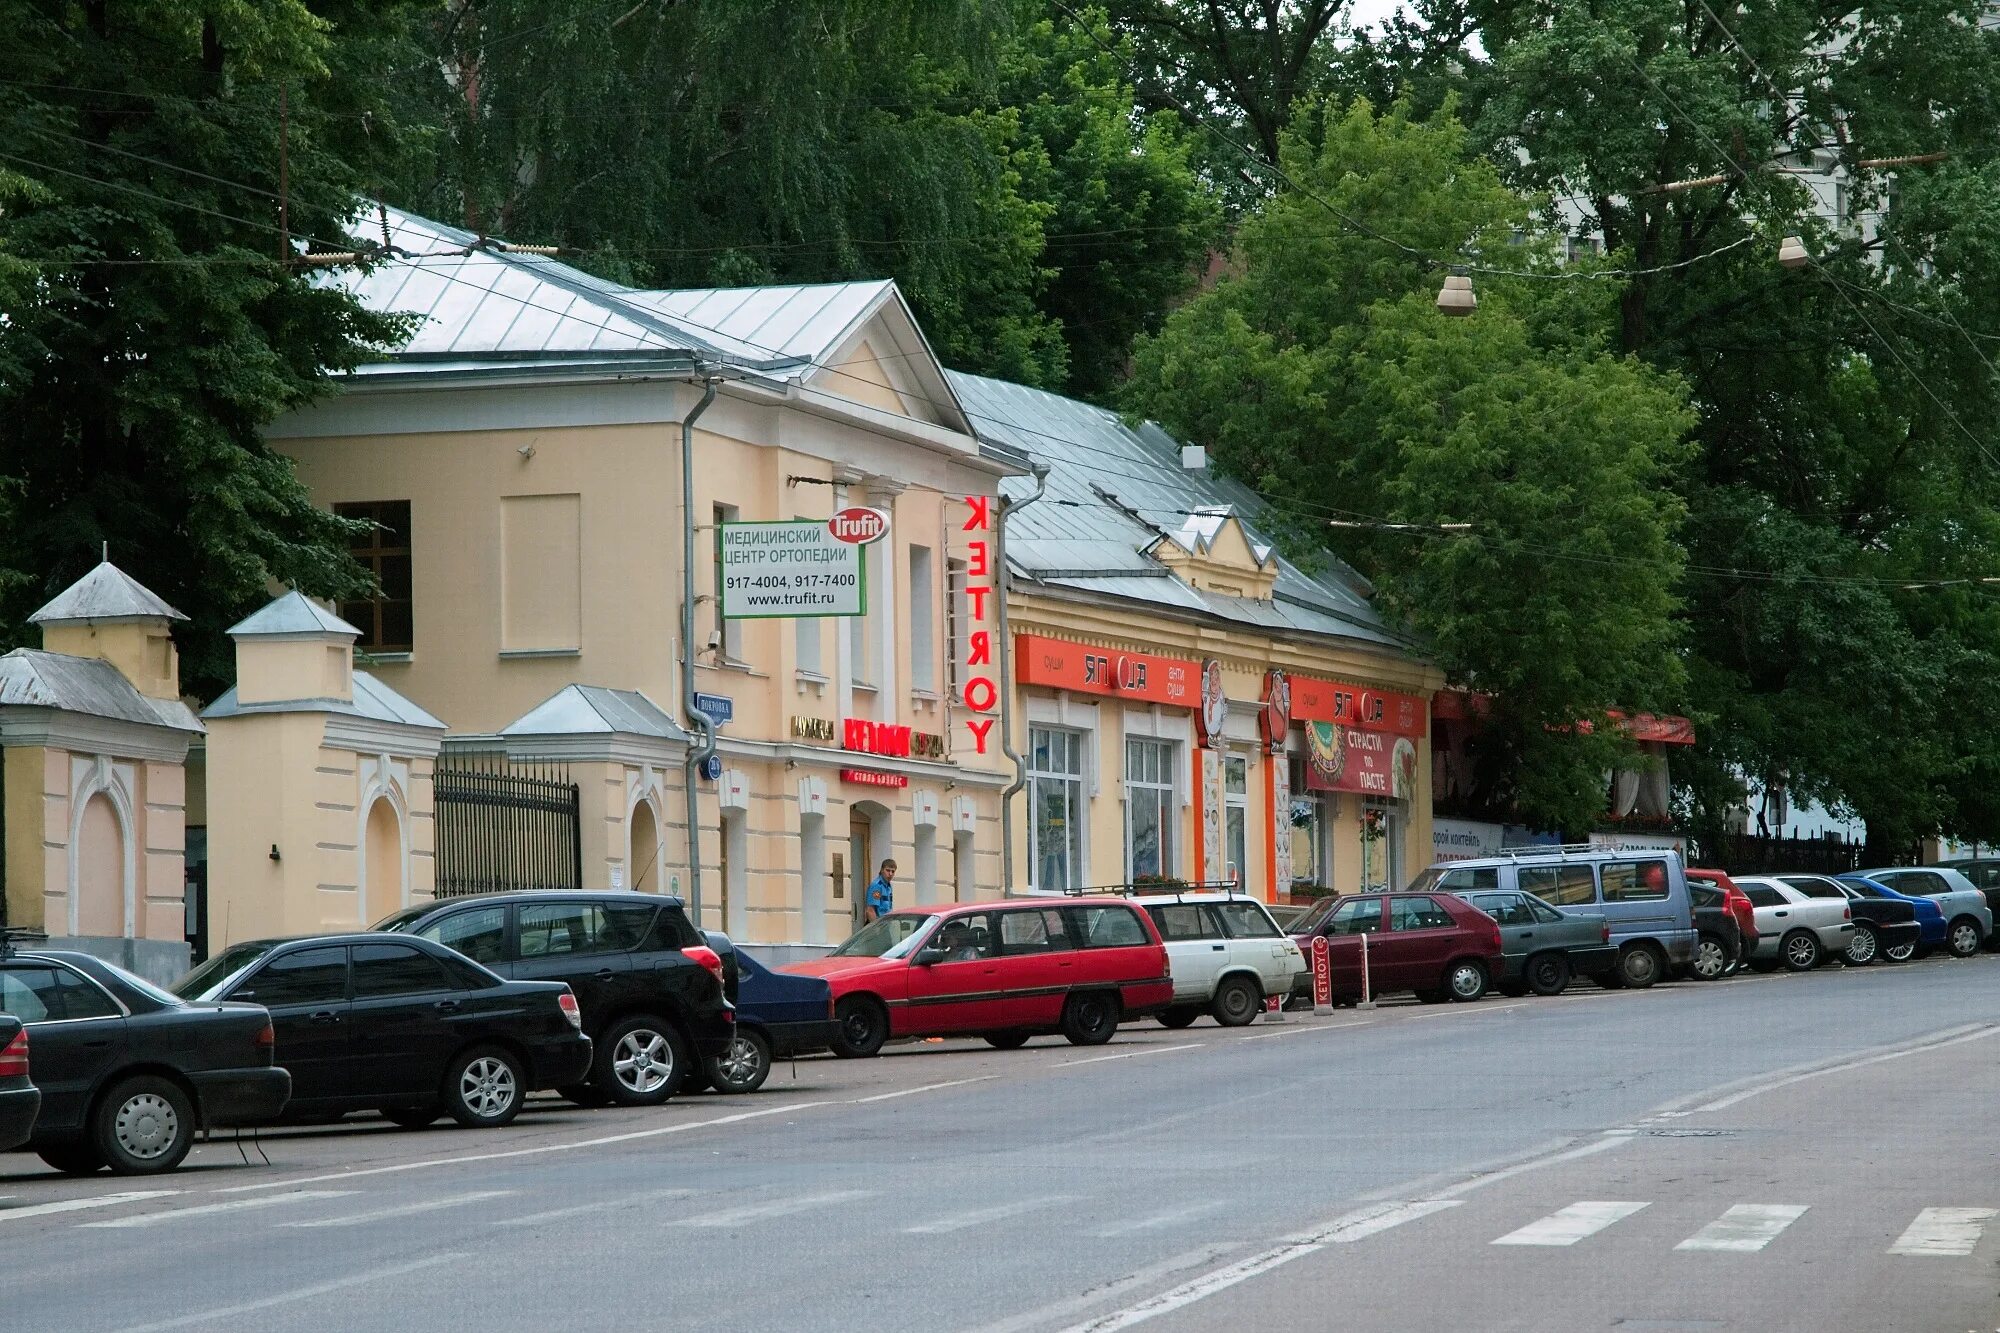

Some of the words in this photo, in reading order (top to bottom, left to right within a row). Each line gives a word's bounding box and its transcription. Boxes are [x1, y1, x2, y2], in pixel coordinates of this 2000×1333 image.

[835, 514, 881, 537] Trufit
[725, 527, 821, 547] МЕДИЦИНСКИЙ
[725, 550, 766, 566] ЦЕНТР
[769, 548, 847, 564] ОРТОПЕДИИ
[726, 575, 791, 590] 917-4004,
[795, 574, 856, 588] 917-7400
[747, 592, 835, 606] www.trufit.ru
[1347, 731, 1384, 752] СТРАСТИ
[1359, 771, 1386, 791] ПАСТЕ
[1450, 831, 1481, 847] коктейль
[1318, 957, 1328, 1001] KETROY
